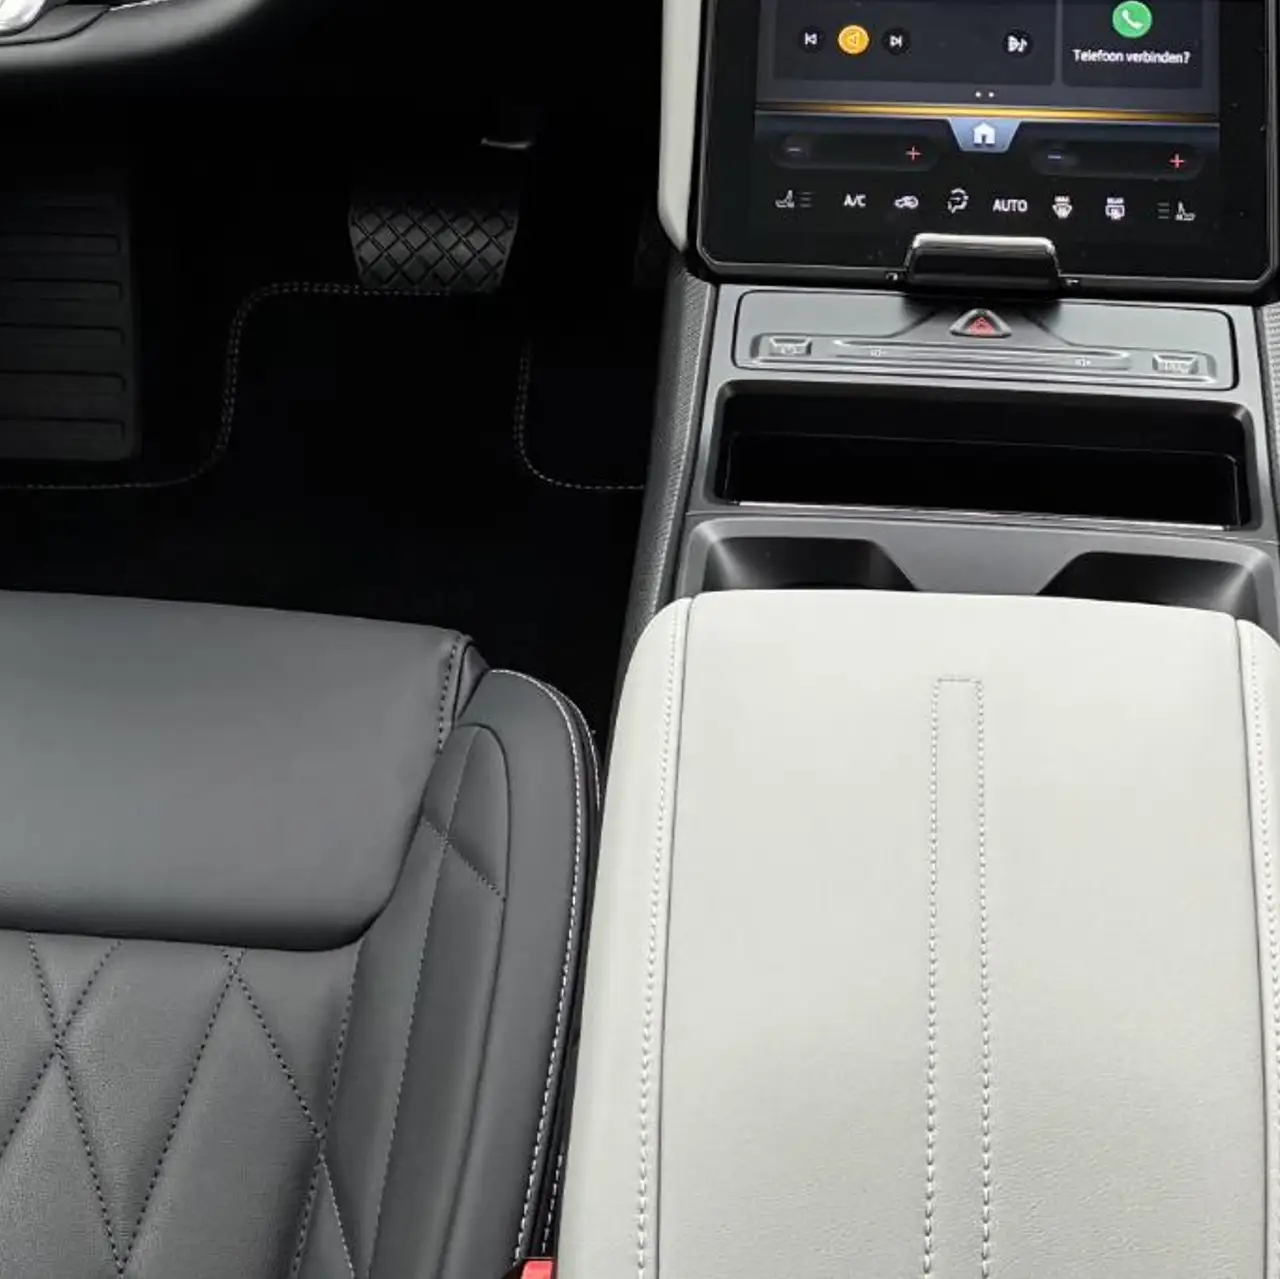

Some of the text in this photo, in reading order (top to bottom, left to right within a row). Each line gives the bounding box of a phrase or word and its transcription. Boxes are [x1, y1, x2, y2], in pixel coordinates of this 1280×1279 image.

[1072, 49, 1191, 64] Telefoon verbinden?
[843, 193, 867, 207] A/C
[992, 198, 1028, 213] AUTO
